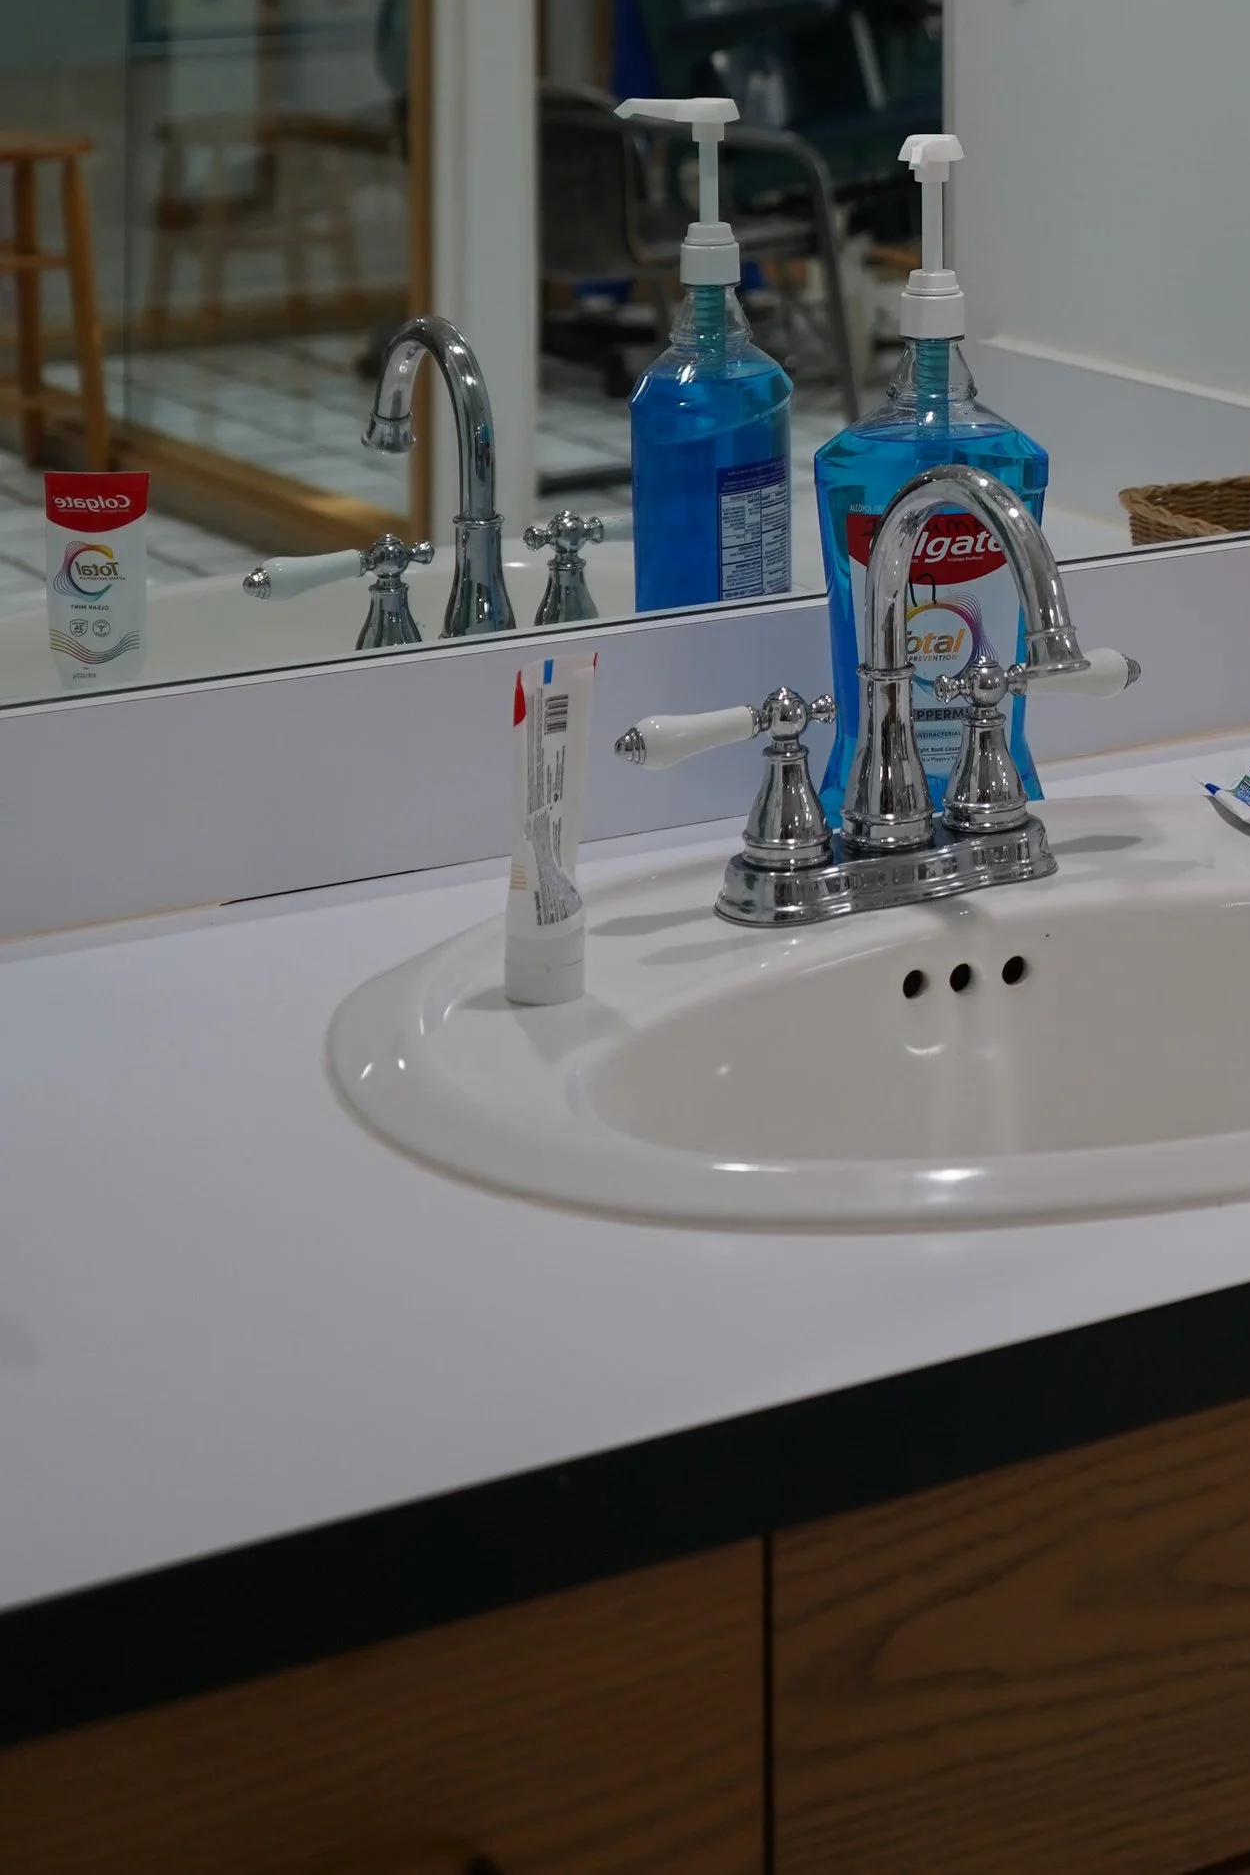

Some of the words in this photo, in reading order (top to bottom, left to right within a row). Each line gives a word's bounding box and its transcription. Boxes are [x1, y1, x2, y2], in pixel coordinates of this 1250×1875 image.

[906, 628, 966, 655] otal
[908, 654, 957, 662] PREVENTION
[913, 708, 969, 721] PPERM
